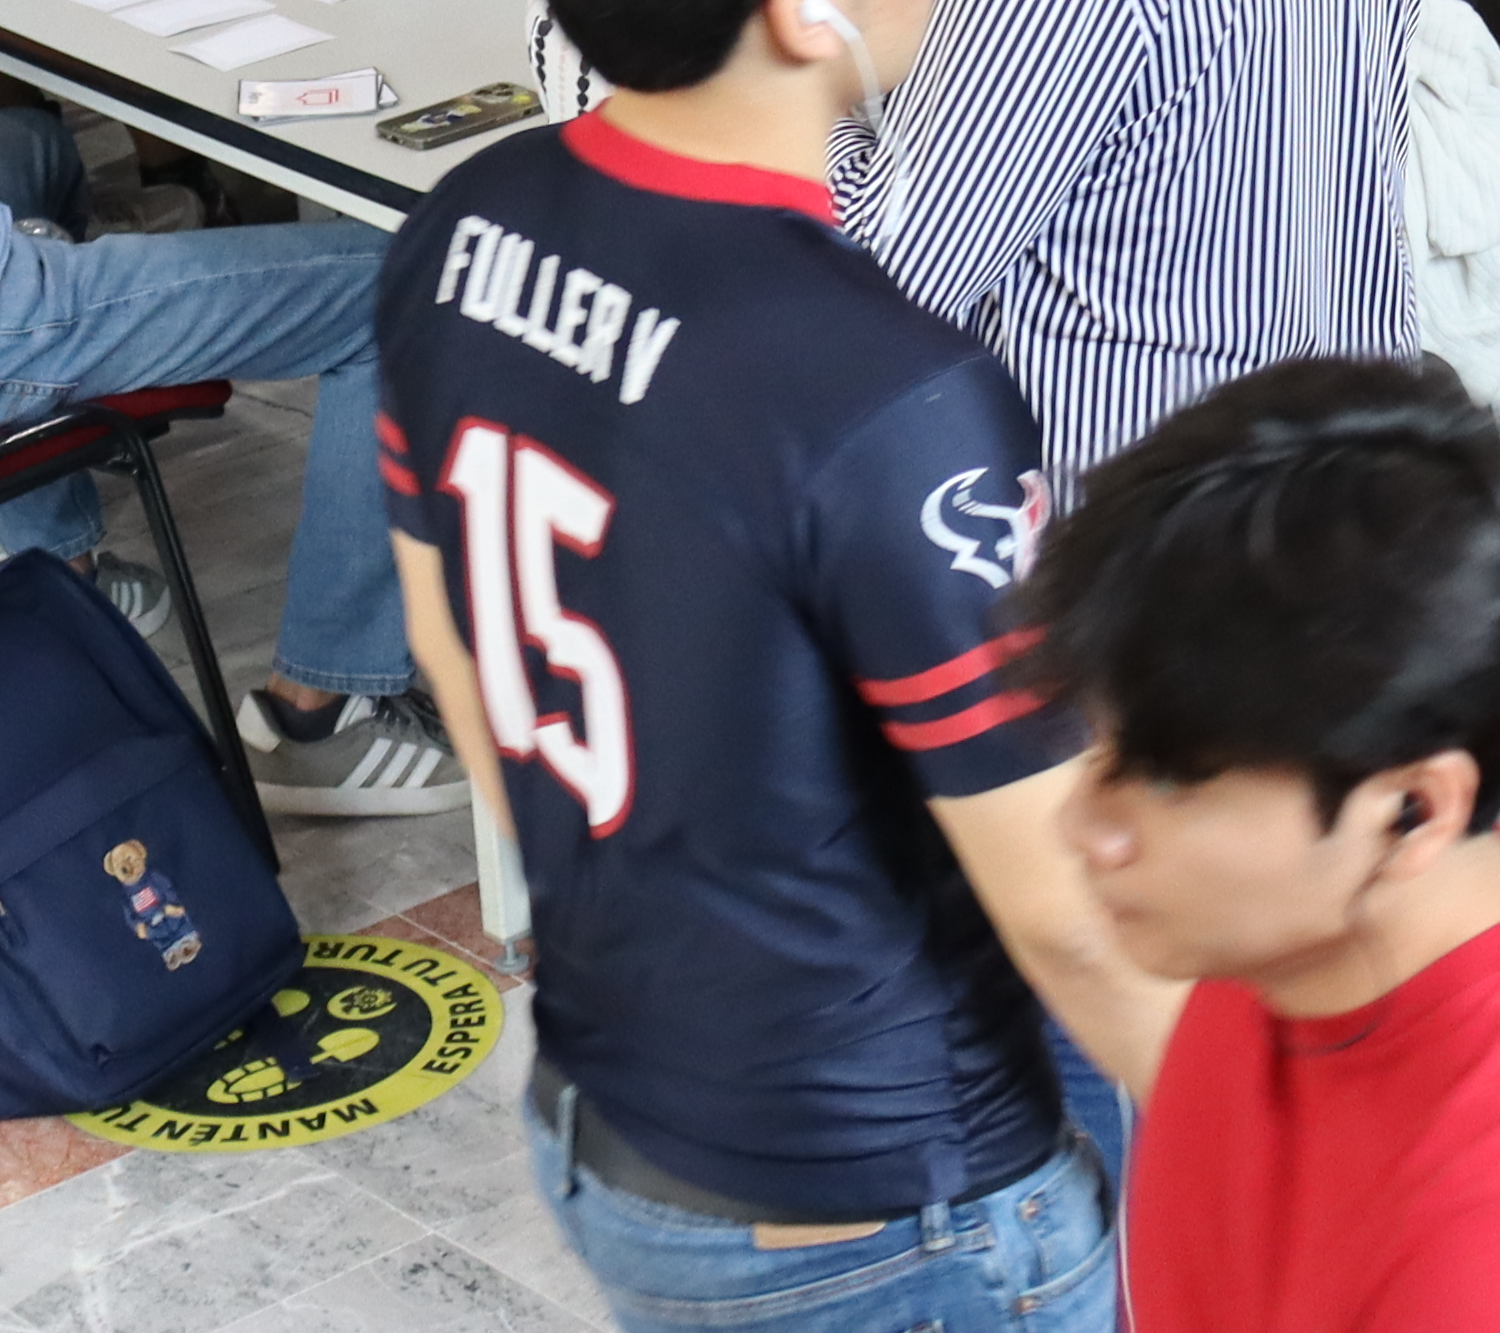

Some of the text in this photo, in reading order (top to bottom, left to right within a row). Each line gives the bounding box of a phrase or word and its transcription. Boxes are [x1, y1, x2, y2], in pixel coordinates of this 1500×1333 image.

[435, 214, 682, 406] FULLER V
[436, 415, 632, 840] 15
[397, 954, 460, 988] TU
[422, 980, 488, 1076] ESPERA
[150, 1096, 380, 1147] MANTÉN
